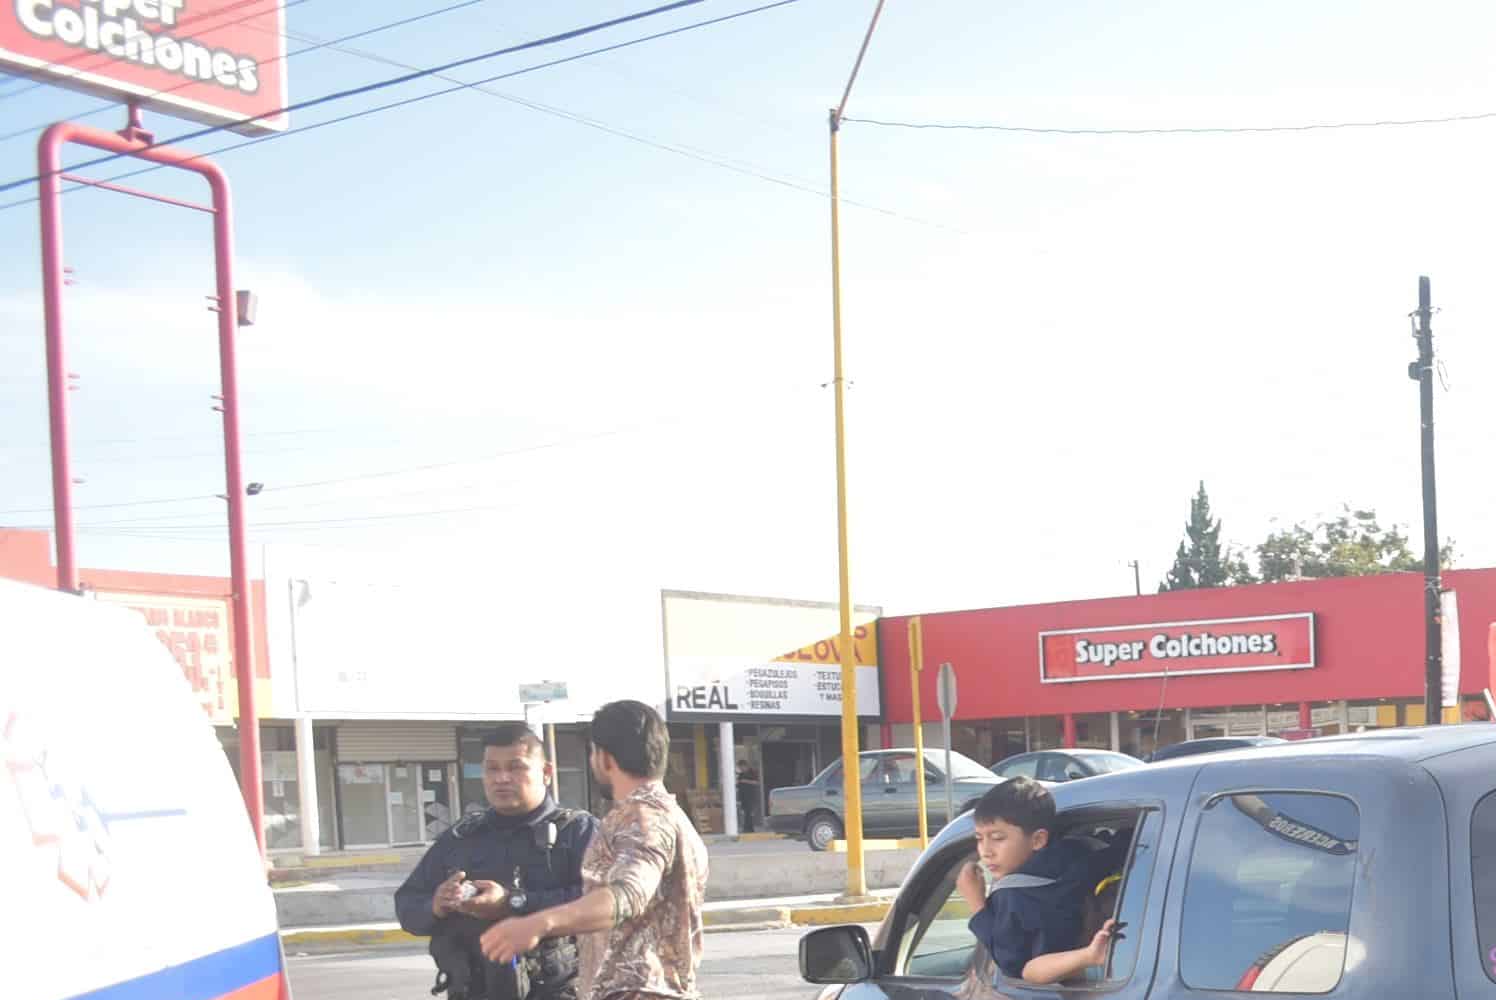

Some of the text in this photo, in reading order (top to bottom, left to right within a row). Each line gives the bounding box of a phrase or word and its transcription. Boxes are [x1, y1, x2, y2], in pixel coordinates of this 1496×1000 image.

[16, 0, 259, 93] Colchones
[1074, 632, 1278, 667] Super Colchones
[816, 671, 843, 682] TEXTU
[816, 681, 843, 692] ESTUC
